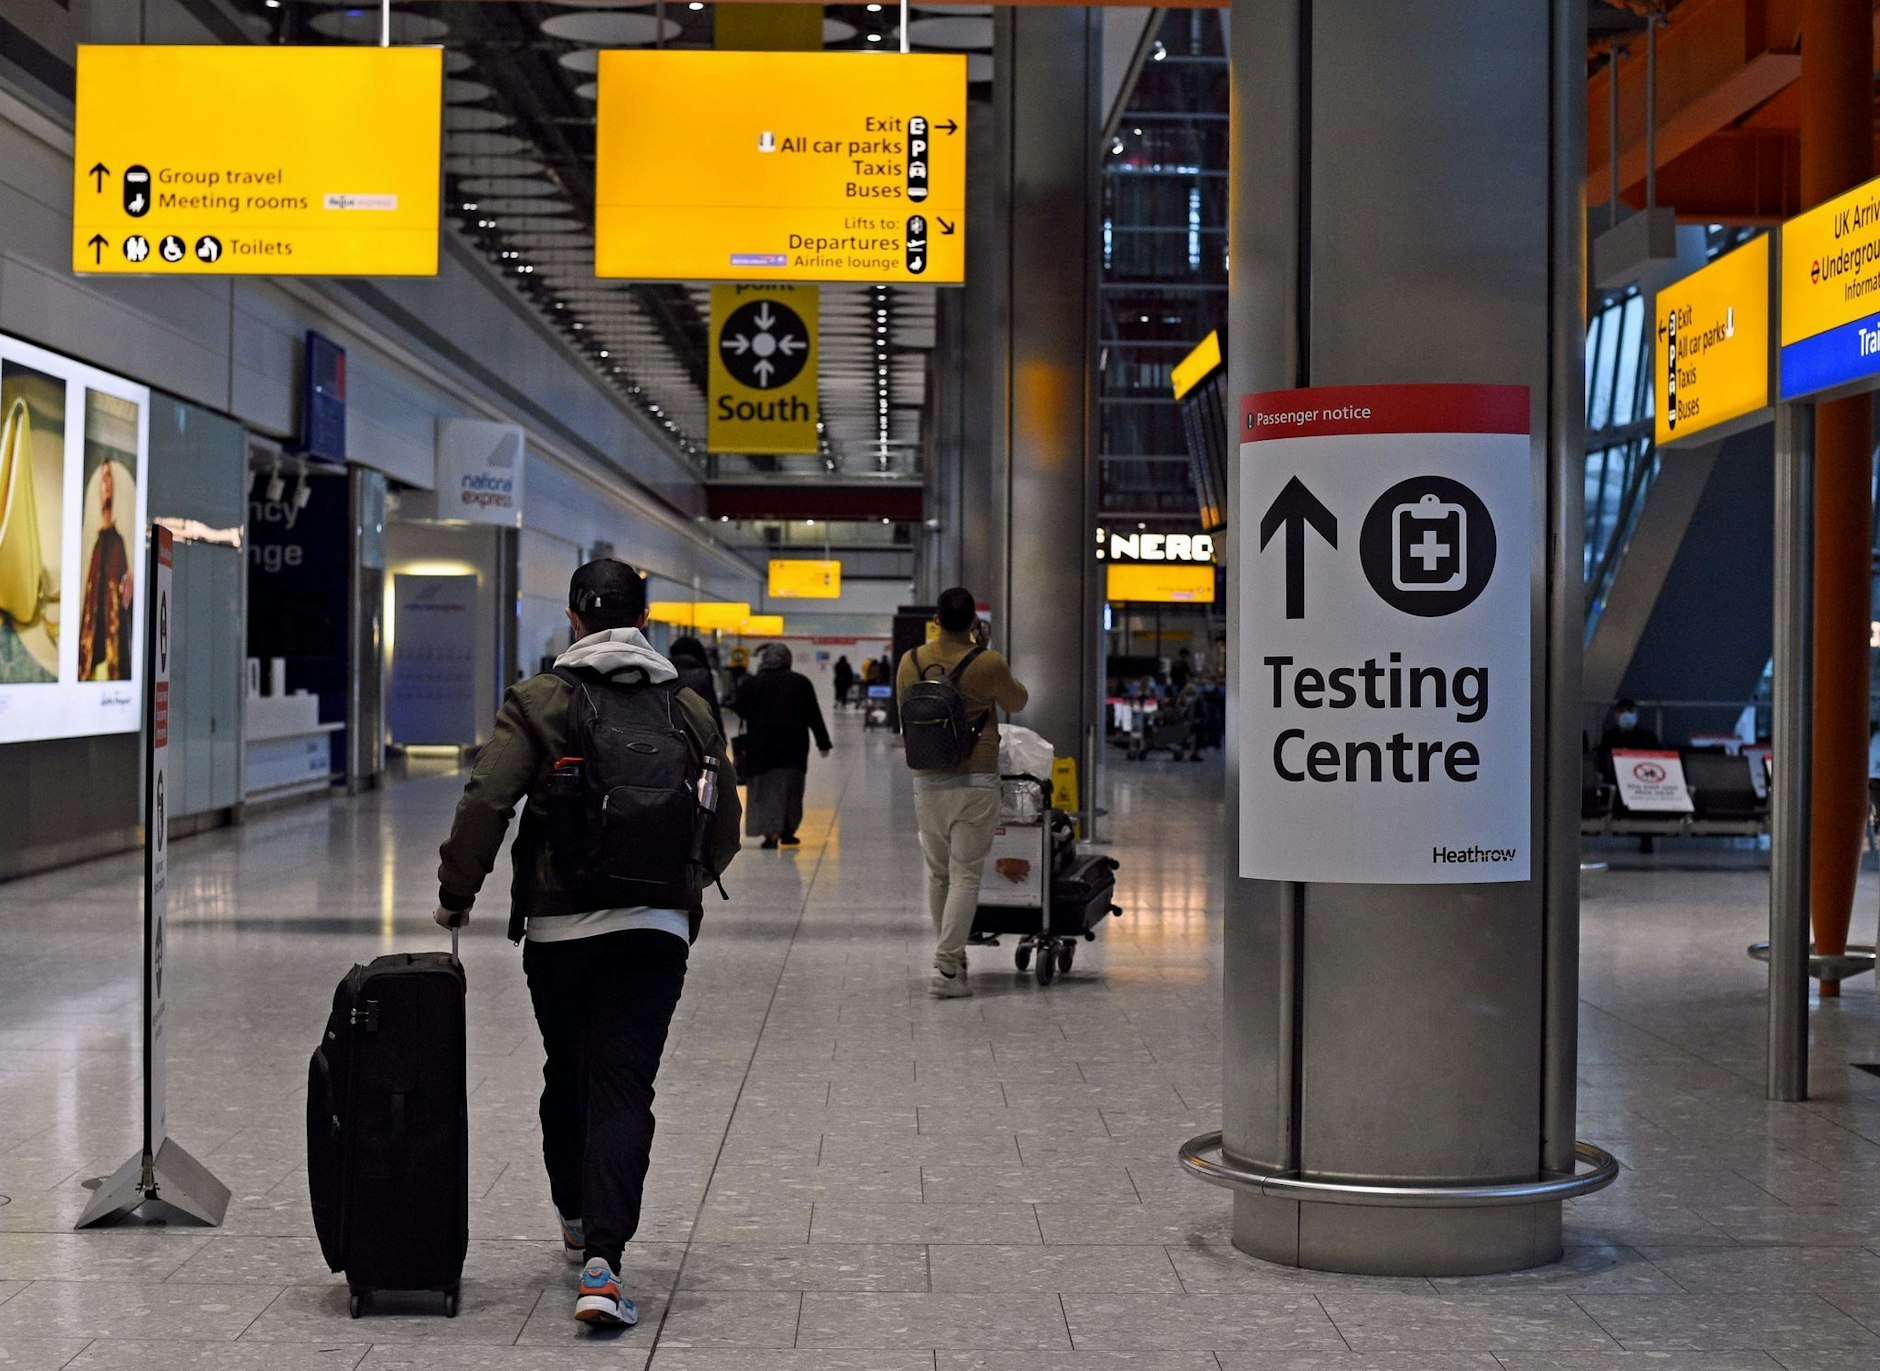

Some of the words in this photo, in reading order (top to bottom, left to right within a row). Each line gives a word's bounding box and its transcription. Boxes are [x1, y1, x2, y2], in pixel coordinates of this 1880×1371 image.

[866, 116, 902, 132] Exit
[780, 137, 806, 152] All
[813, 141, 841, 152] car
[848, 137, 902, 156] parks
[852, 160, 902, 175] Taxis
[158, 168, 219, 187] Group
[226, 169, 282, 184] travel
[845, 183, 902, 198] Buses
[158, 193, 240, 212] Meeting
[246, 198, 308, 209] rooms
[844, 216, 876, 230] Lifts
[1834, 209, 1850, 239] UK
[230, 239, 292, 255] Toilets
[789, 234, 900, 253] Departures
[794, 255, 843, 268] Airline
[848, 256, 899, 271] lounge
[1678, 304, 1693, 330] Exit
[1677, 335, 1688, 361] All
[1689, 335, 1702, 356] car
[1703, 320, 1726, 356] parks
[1677, 362, 1697, 390] Taxis
[717, 395, 810, 422] South
[1257, 410, 1319, 426] Passenger
[1322, 405, 1371, 420] notice
[1678, 397, 1700, 421] Buses
[1263, 652, 1490, 724] Testing
[1273, 728, 1481, 783] Centre
[1432, 845, 1517, 864] Heathrow
